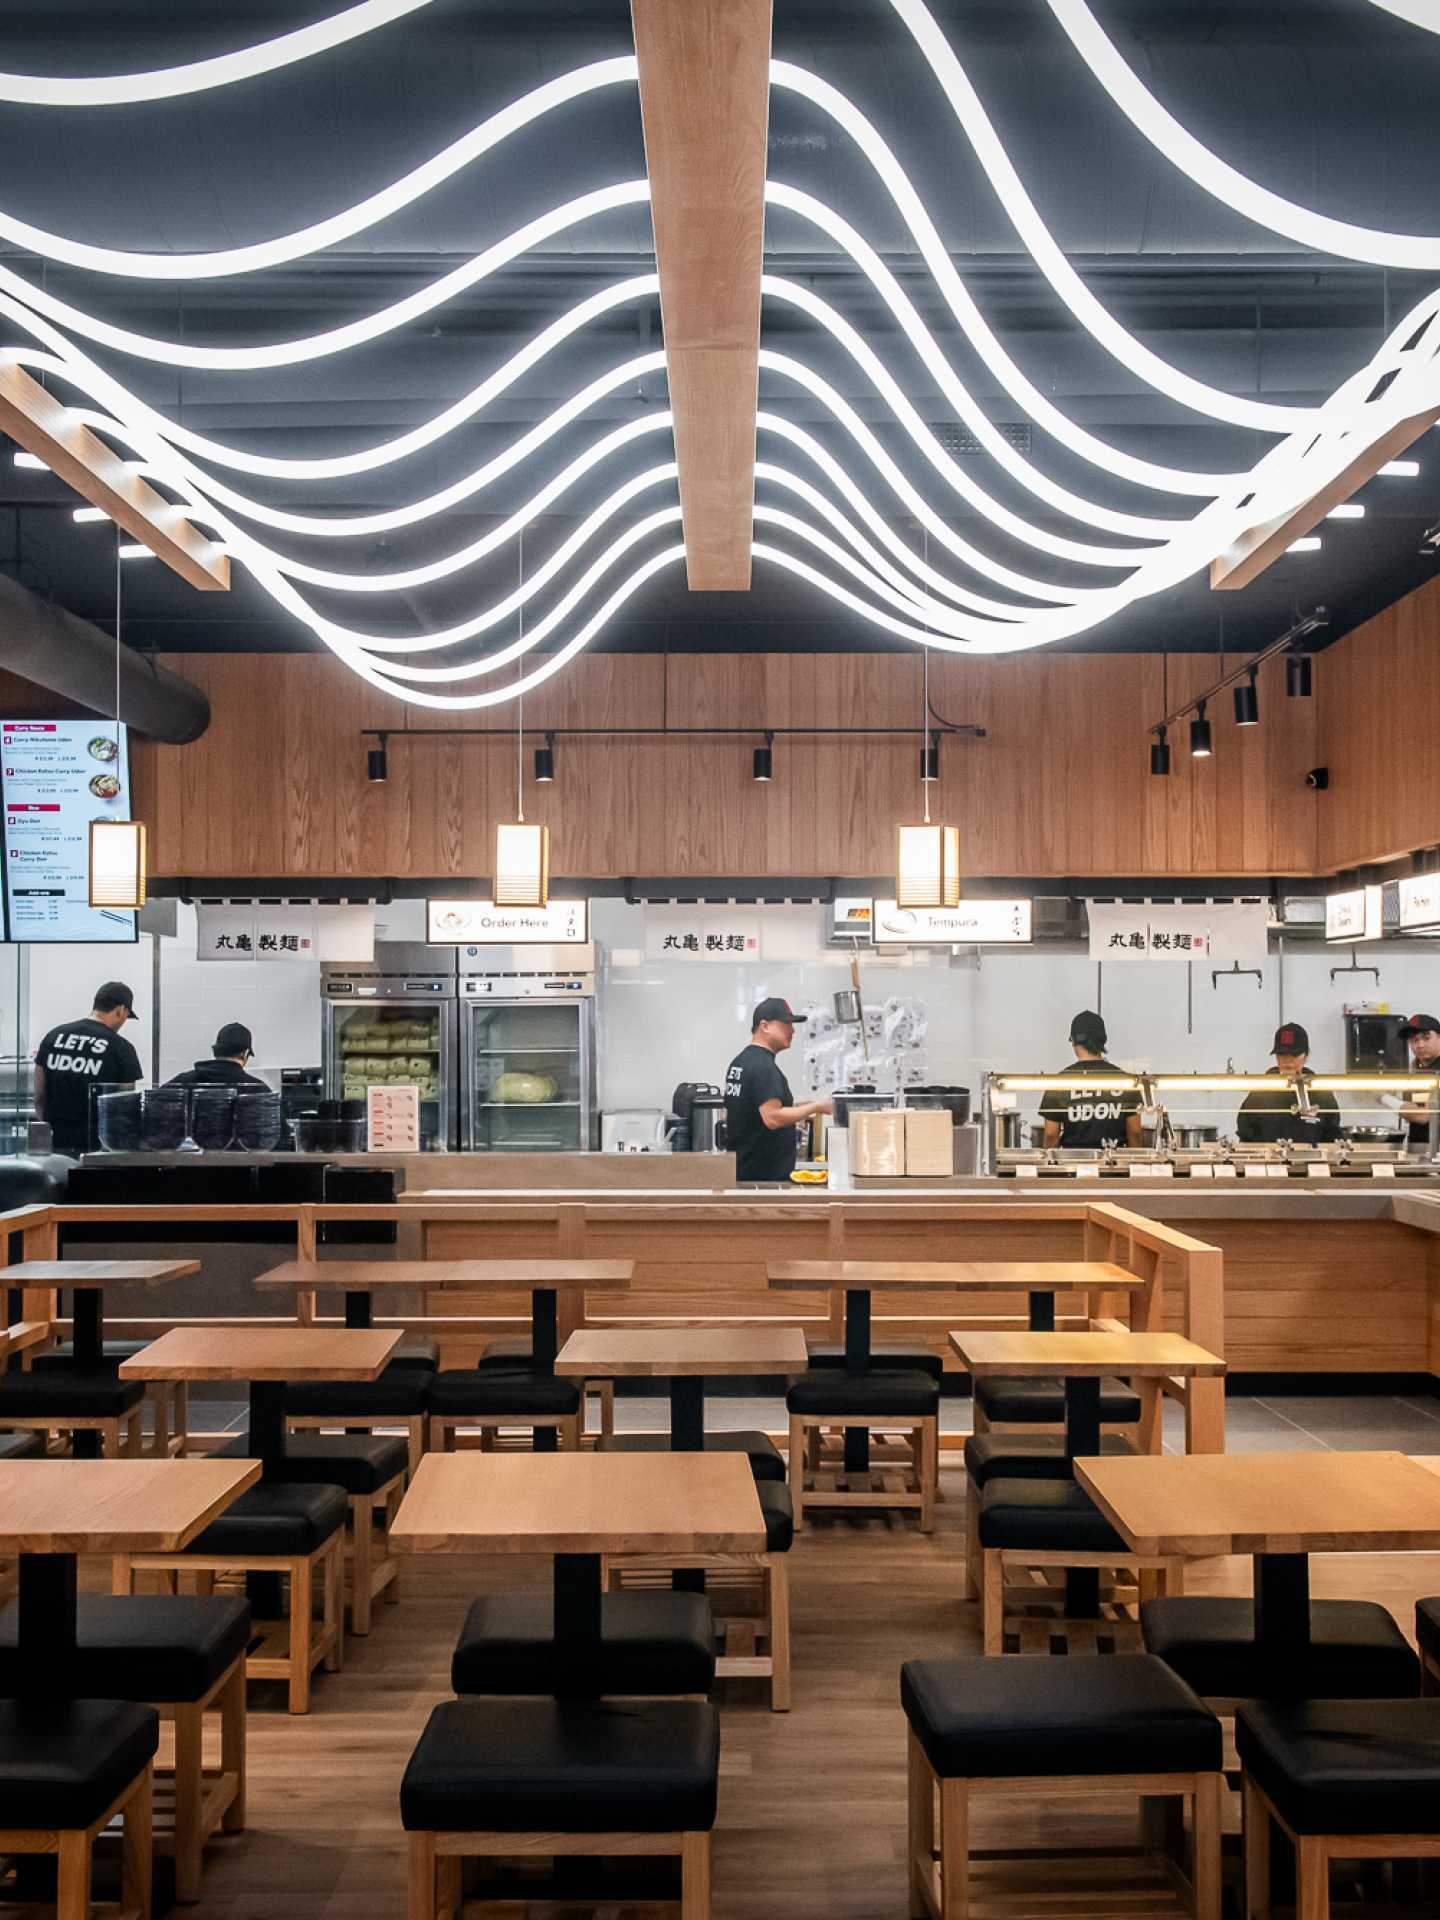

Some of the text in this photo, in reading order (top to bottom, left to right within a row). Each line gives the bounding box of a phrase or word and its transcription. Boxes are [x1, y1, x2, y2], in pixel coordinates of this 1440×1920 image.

[481, 917, 549, 928] Order Here
[928, 917, 979, 929] Tempura
[53, 1032, 109, 1054] LET'S
[46, 1053, 103, 1076] UDON
[1067, 1102, 1122, 1121] UDON
